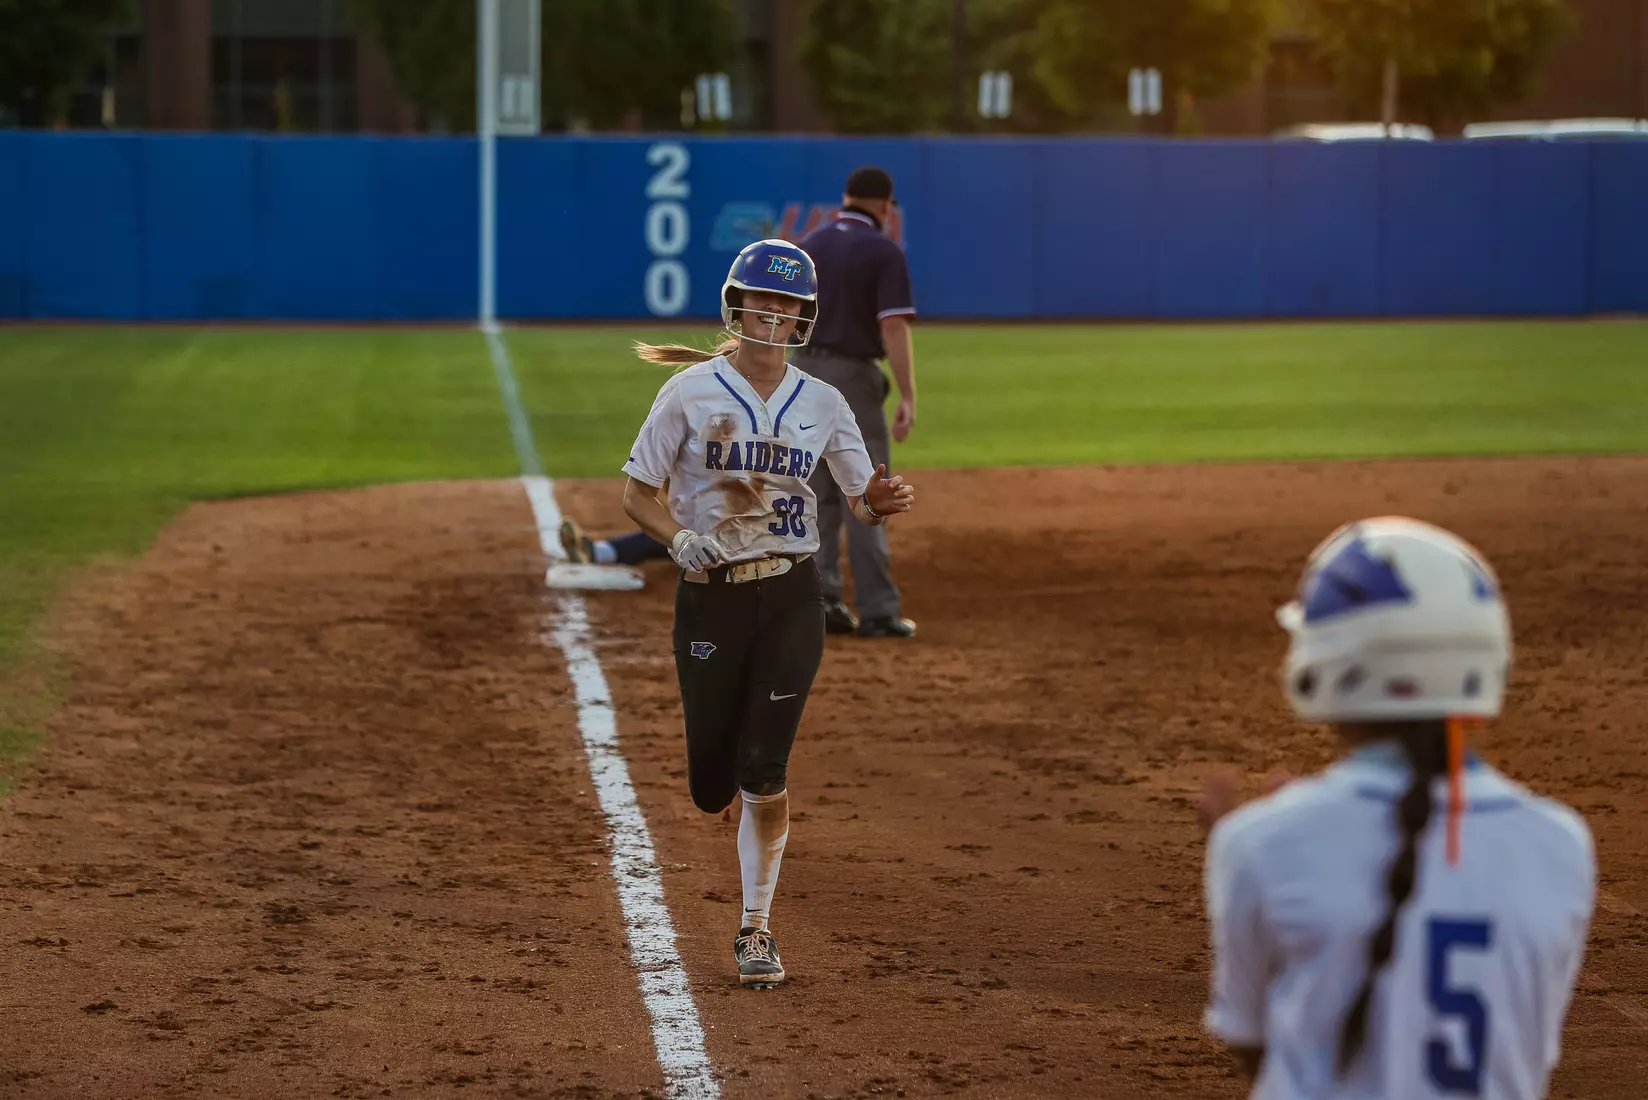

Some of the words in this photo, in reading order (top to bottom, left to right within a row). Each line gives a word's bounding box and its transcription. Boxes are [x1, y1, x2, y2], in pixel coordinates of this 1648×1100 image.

[645, 143, 691, 315] 200
[767, 257, 801, 281] MT
[706, 441, 813, 478] RAIDERS
[1426, 917, 1493, 1094] 5
